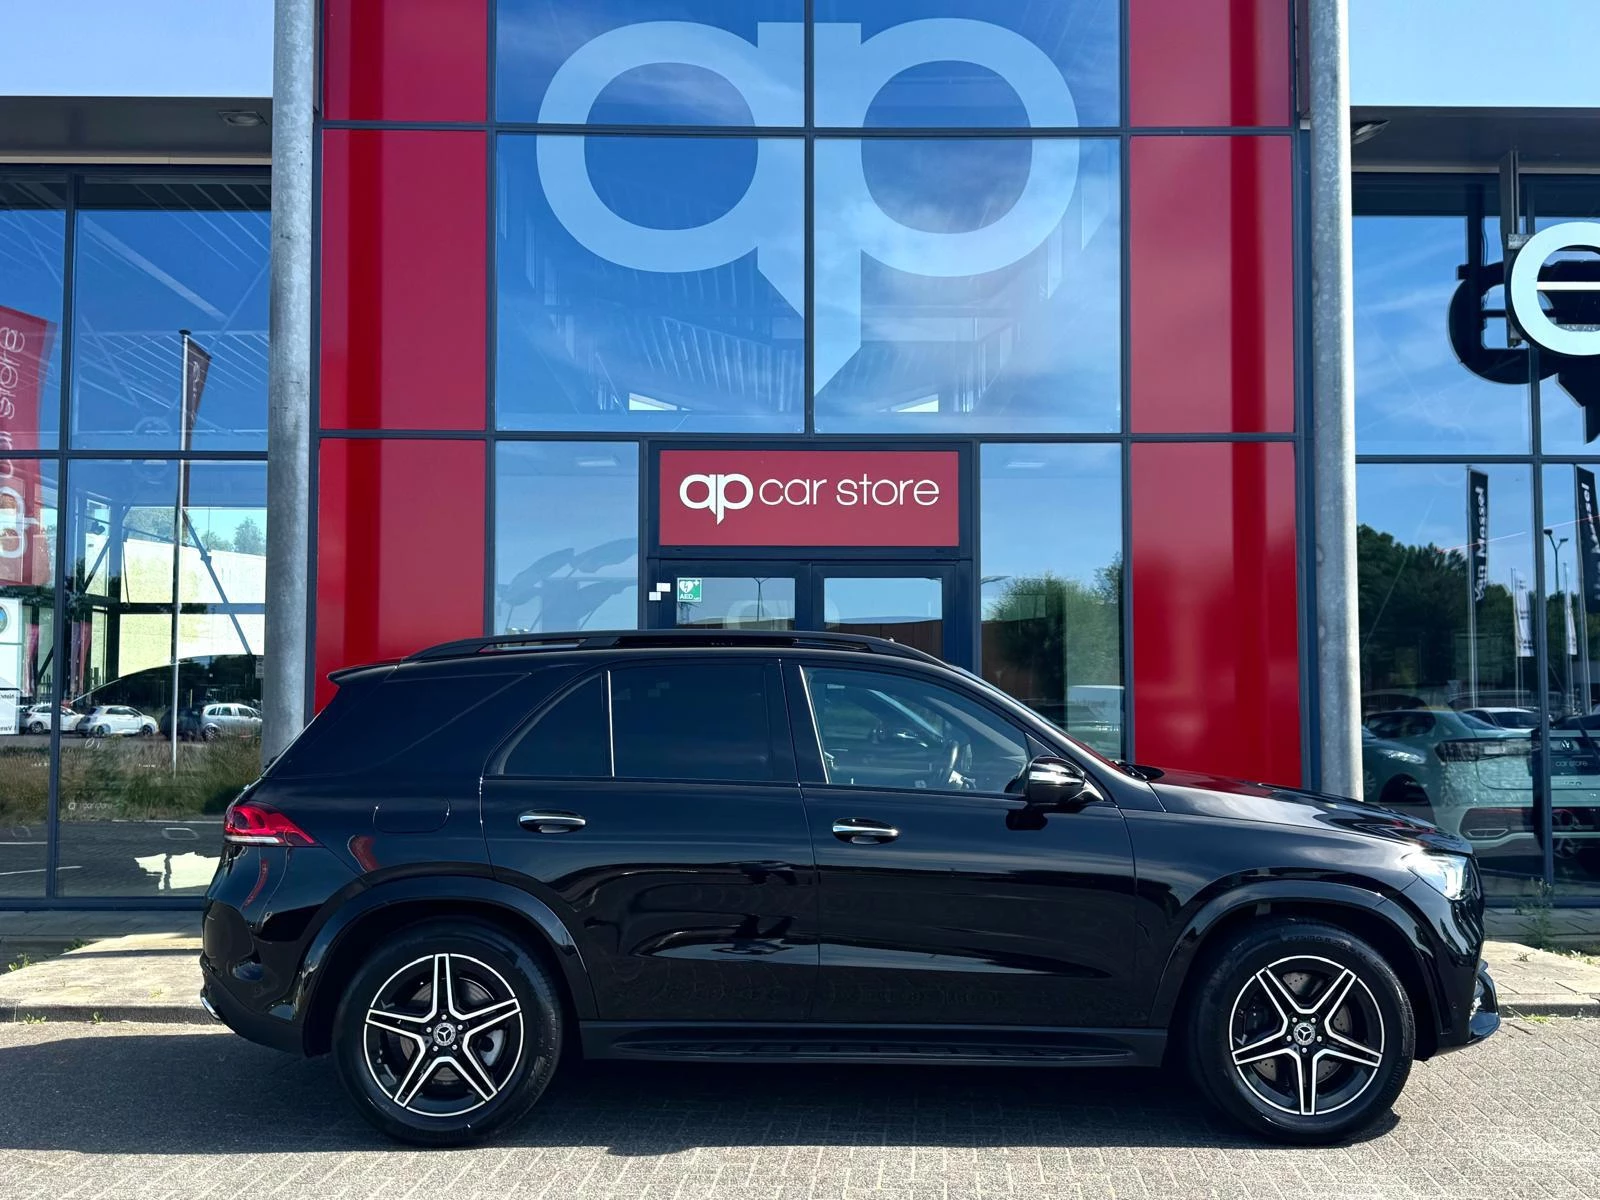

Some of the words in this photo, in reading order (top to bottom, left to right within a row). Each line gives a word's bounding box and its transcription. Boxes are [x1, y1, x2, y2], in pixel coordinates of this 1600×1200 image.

[536, 18, 1080, 396] ap
[679, 473, 754, 526] ap
[758, 478, 828, 506] car
[836, 473, 940, 506] store
